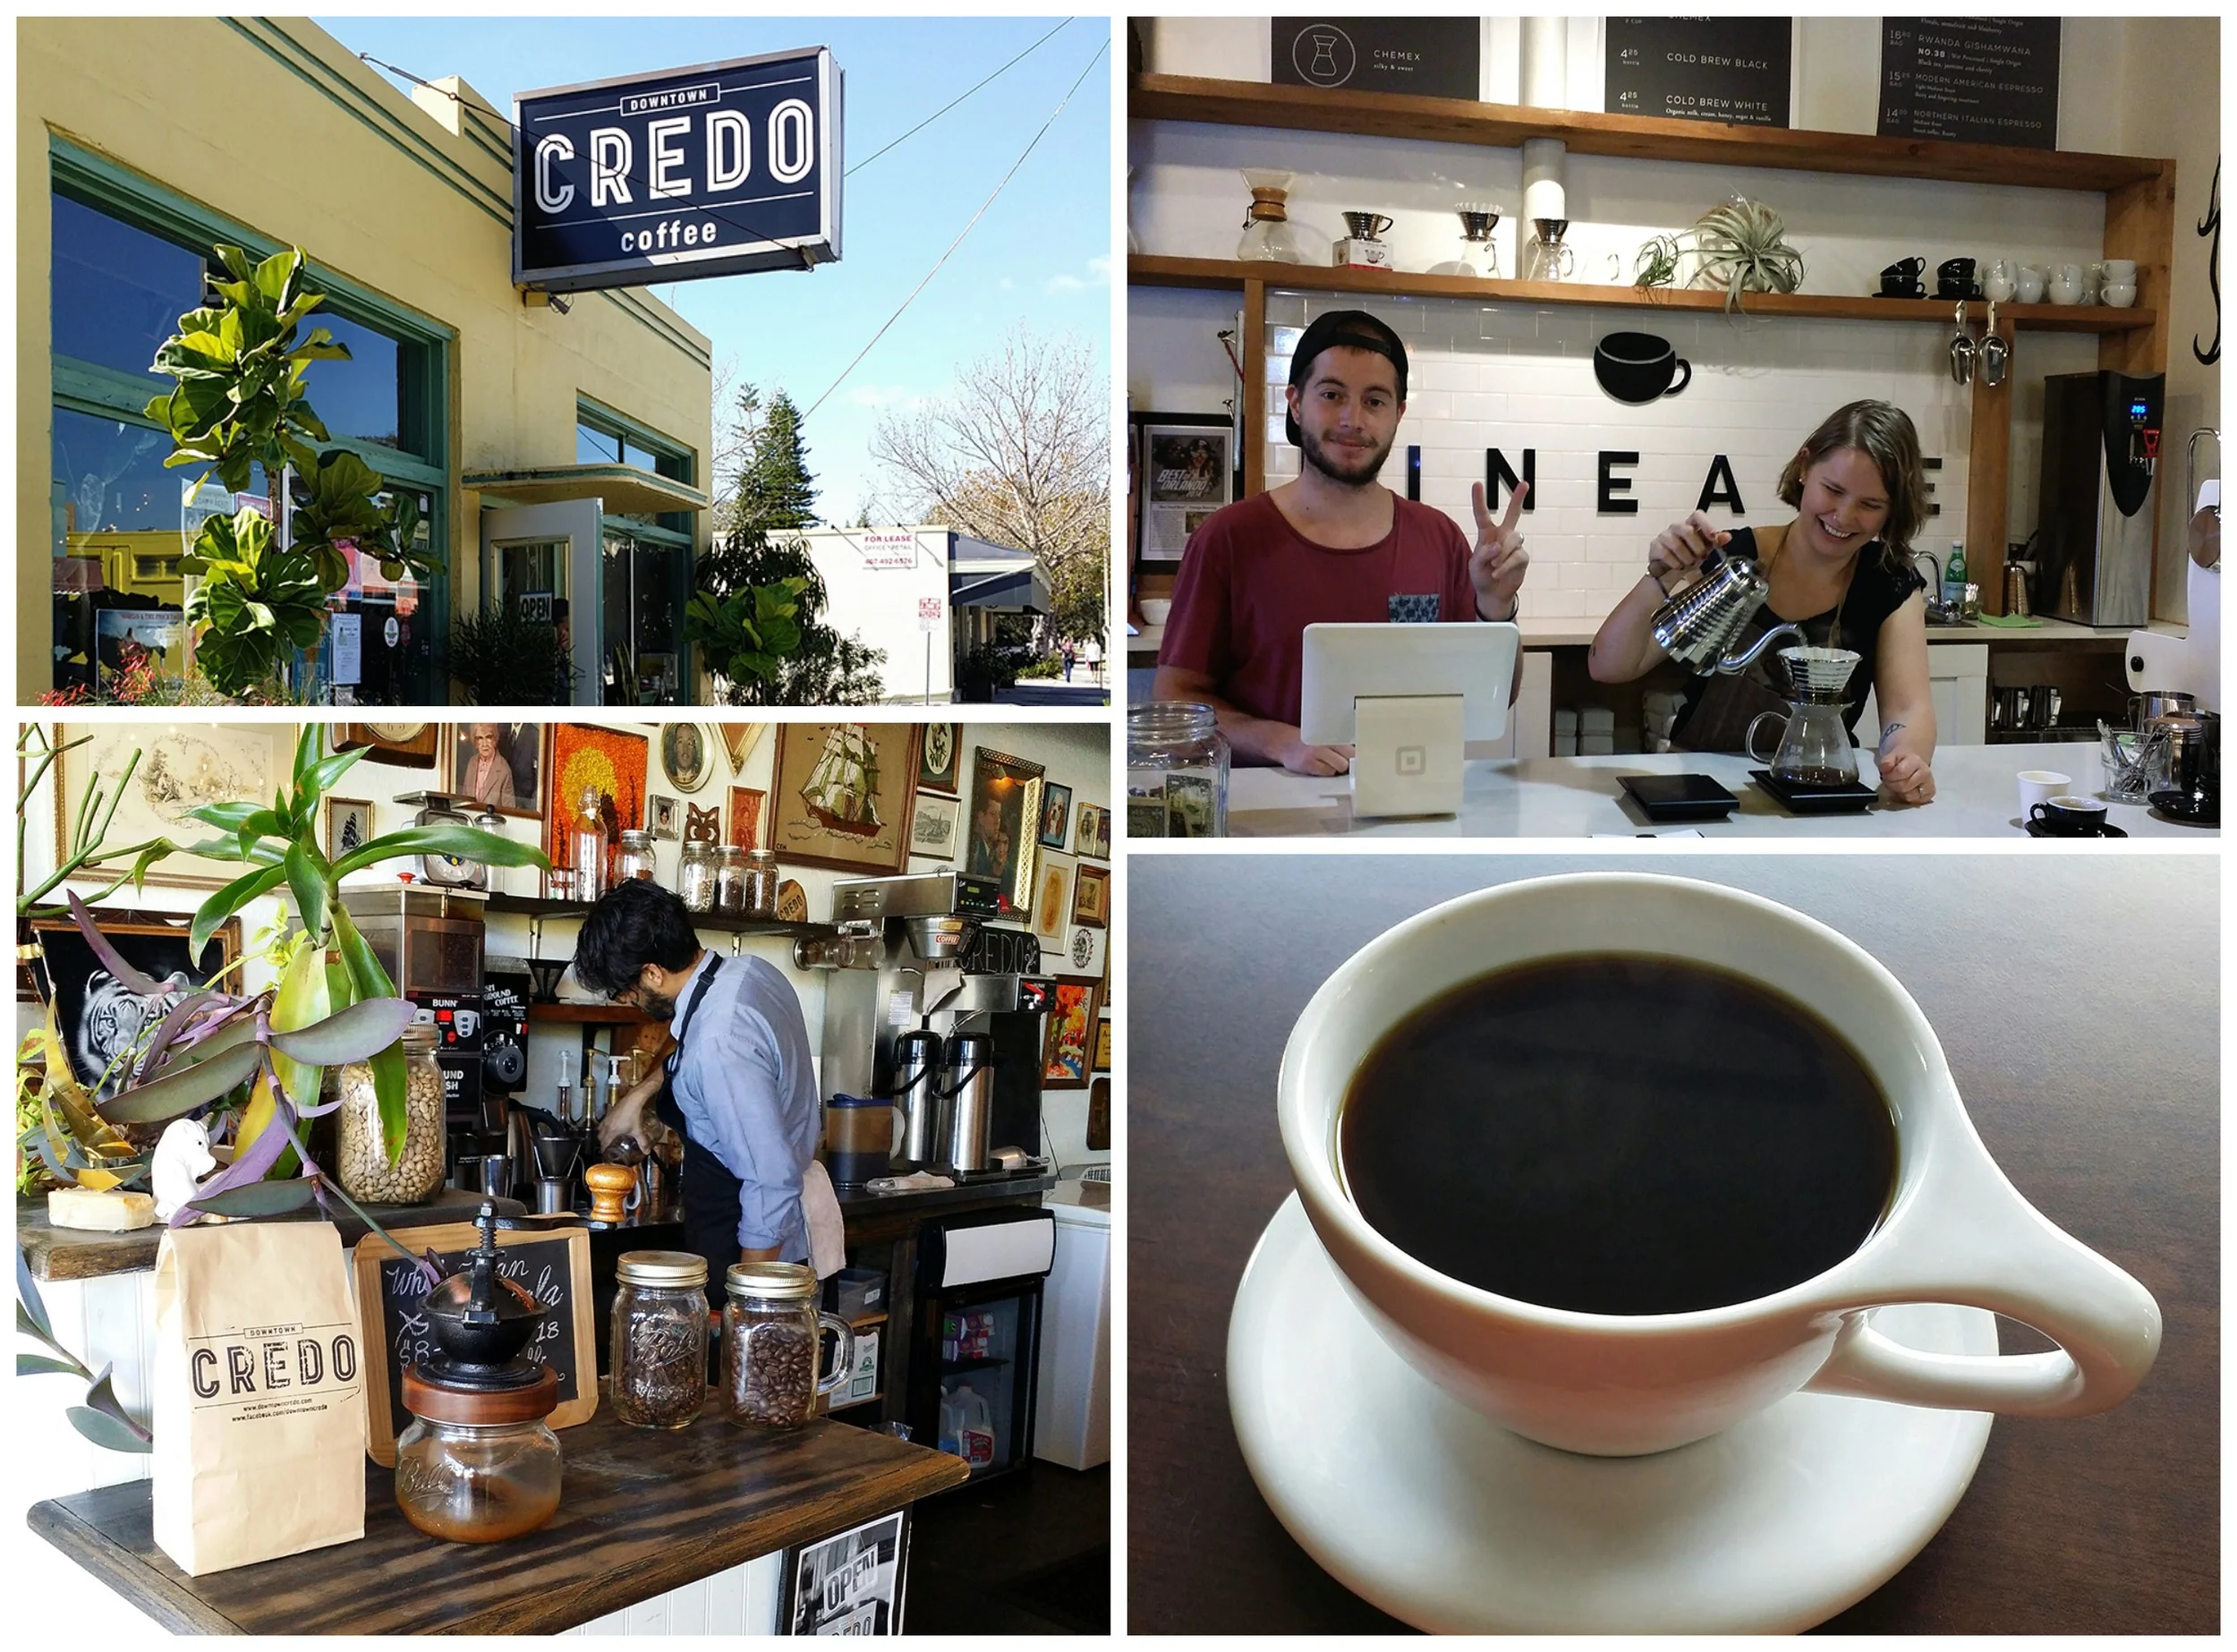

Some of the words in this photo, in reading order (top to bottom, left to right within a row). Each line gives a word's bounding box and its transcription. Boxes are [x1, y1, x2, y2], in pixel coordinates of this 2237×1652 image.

[1374, 49, 1421, 61] CHEMEX
[1666, 52, 1697, 64] COLD
[1700, 55, 1731, 66] BREW
[1735, 58, 1769, 70] BLACK
[1915, 72, 1951, 84] MODERN
[1952, 78, 1996, 89] AMERICAN
[1998, 82, 2045, 93] ESPRESSO
[630, 89, 708, 112] DOWNTOWN
[1665, 95, 1696, 106] COLD
[1699, 98, 1731, 108] BREW
[1734, 100, 1768, 112] WHITE
[1914, 109, 1960, 121] NORTHERN
[1961, 115, 1995, 125] ITALIAN
[1997, 117, 2043, 129] ESPRESSO
[534, 99, 814, 214] CREDO
[620, 220, 718, 252] coffee
[1157, 469, 1187, 482] BEST
[1161, 480, 1208, 490] ORLANDO
[522, 597, 549, 619] OPEN
[779, 894, 804, 921] CREDO
[960, 932, 1024, 975] REDO
[495, 994, 519, 1007] COFFEE
[250, 1325, 296, 1337] DOWNTOWN
[191, 1333, 357, 1399] CREDO
[827, 1550, 875, 1611] OPEN
